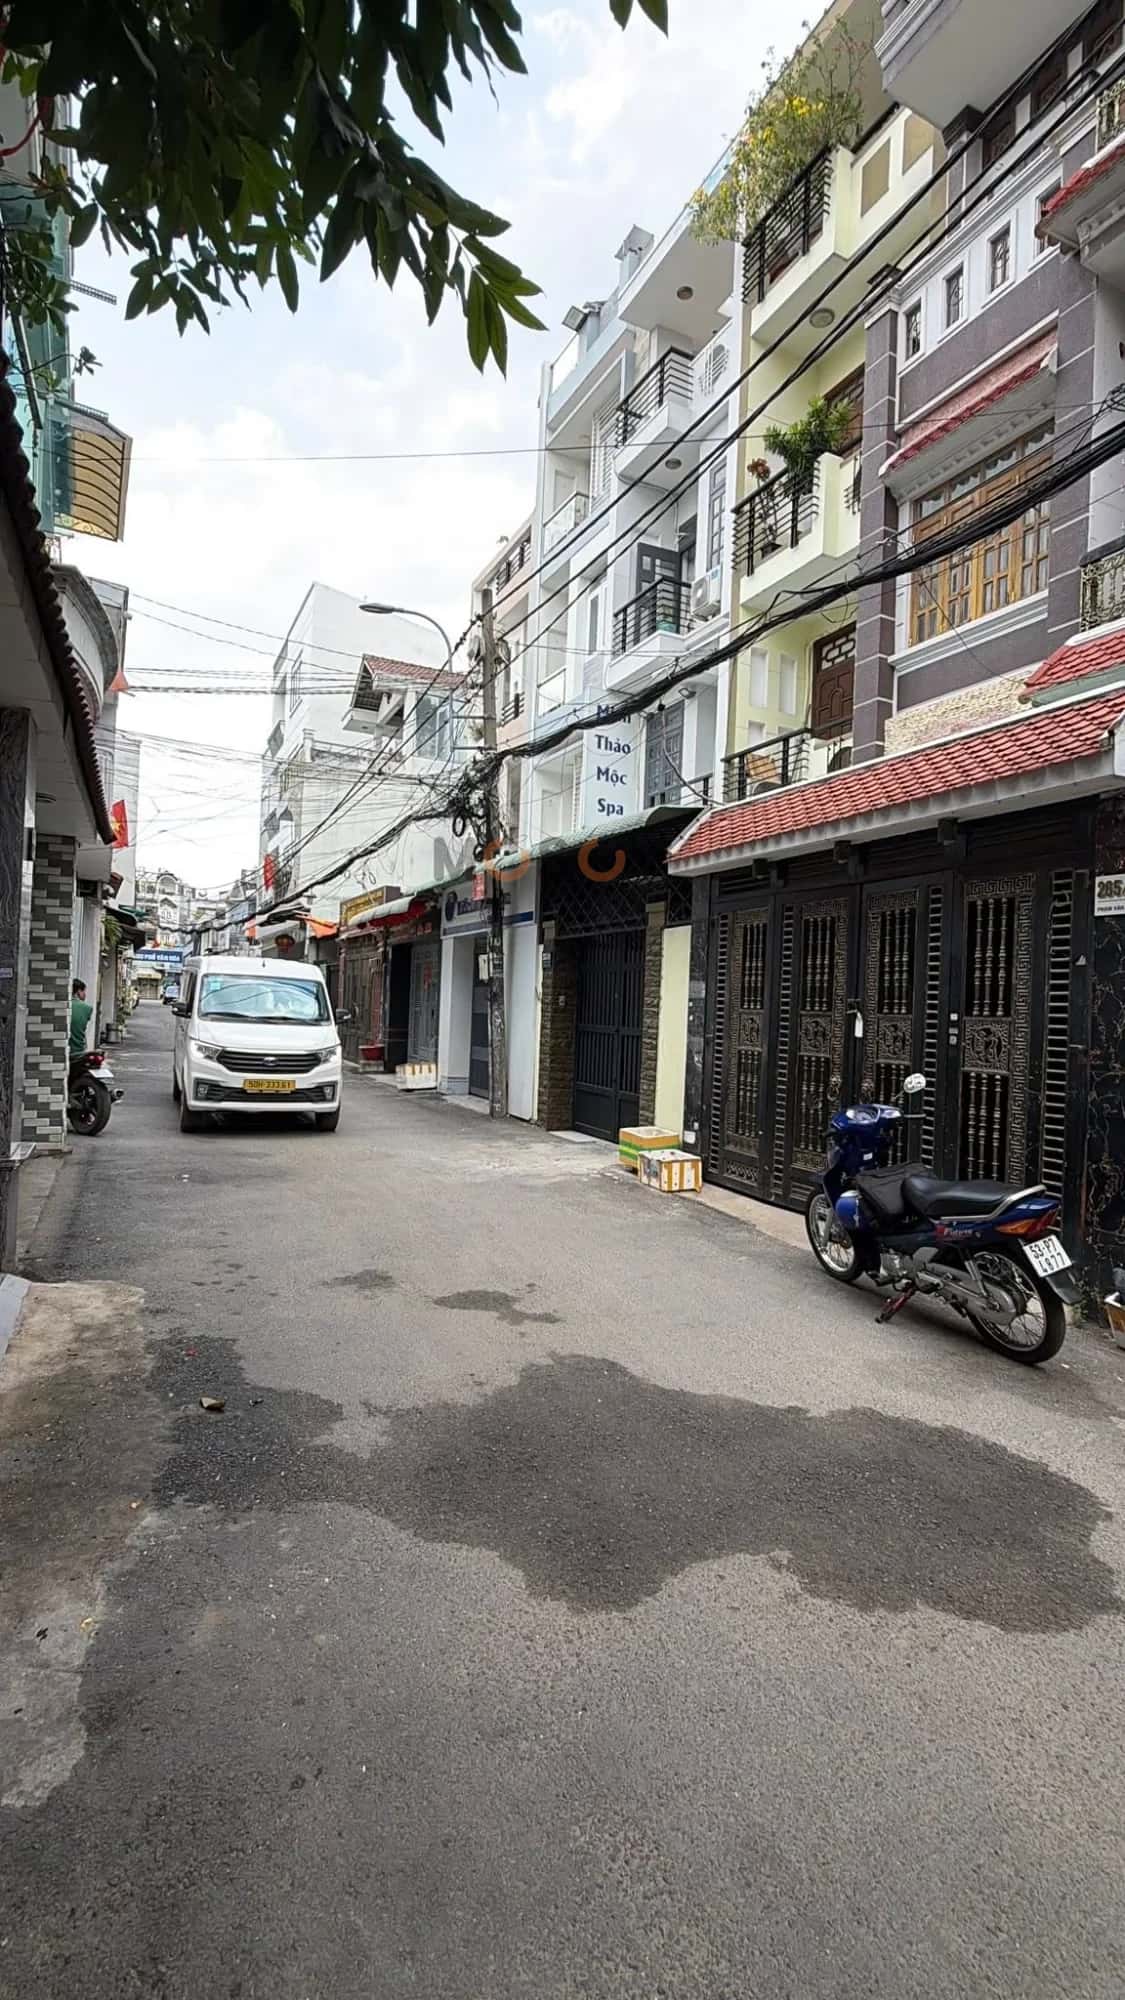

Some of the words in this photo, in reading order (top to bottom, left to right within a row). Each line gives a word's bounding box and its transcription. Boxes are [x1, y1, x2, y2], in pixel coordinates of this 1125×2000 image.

[595, 734, 631, 754] Thảo
[597, 766, 628, 788] Mộc
[597, 798, 624, 817] Spa
